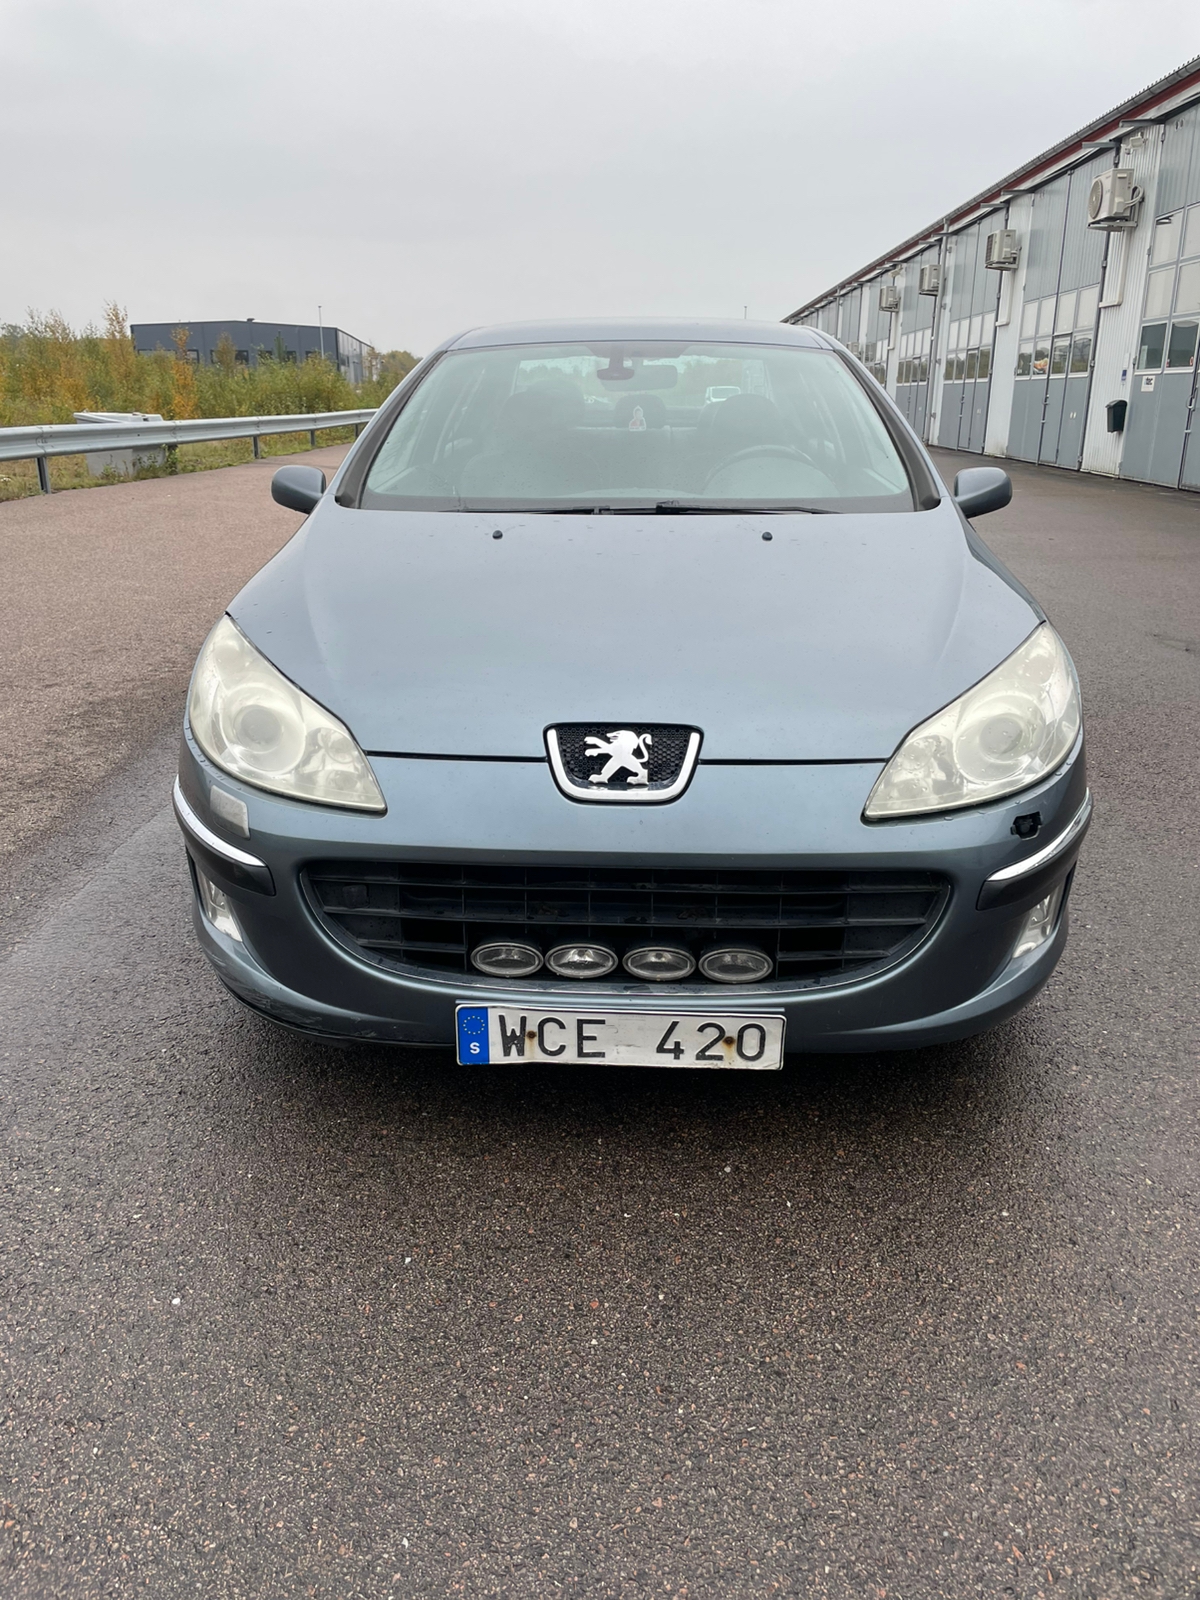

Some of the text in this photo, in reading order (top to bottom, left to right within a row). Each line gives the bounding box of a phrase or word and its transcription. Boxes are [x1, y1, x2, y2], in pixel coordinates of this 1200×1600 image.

[469, 1042, 480, 1054] S
[498, 1014, 767, 1062] WCE 420
